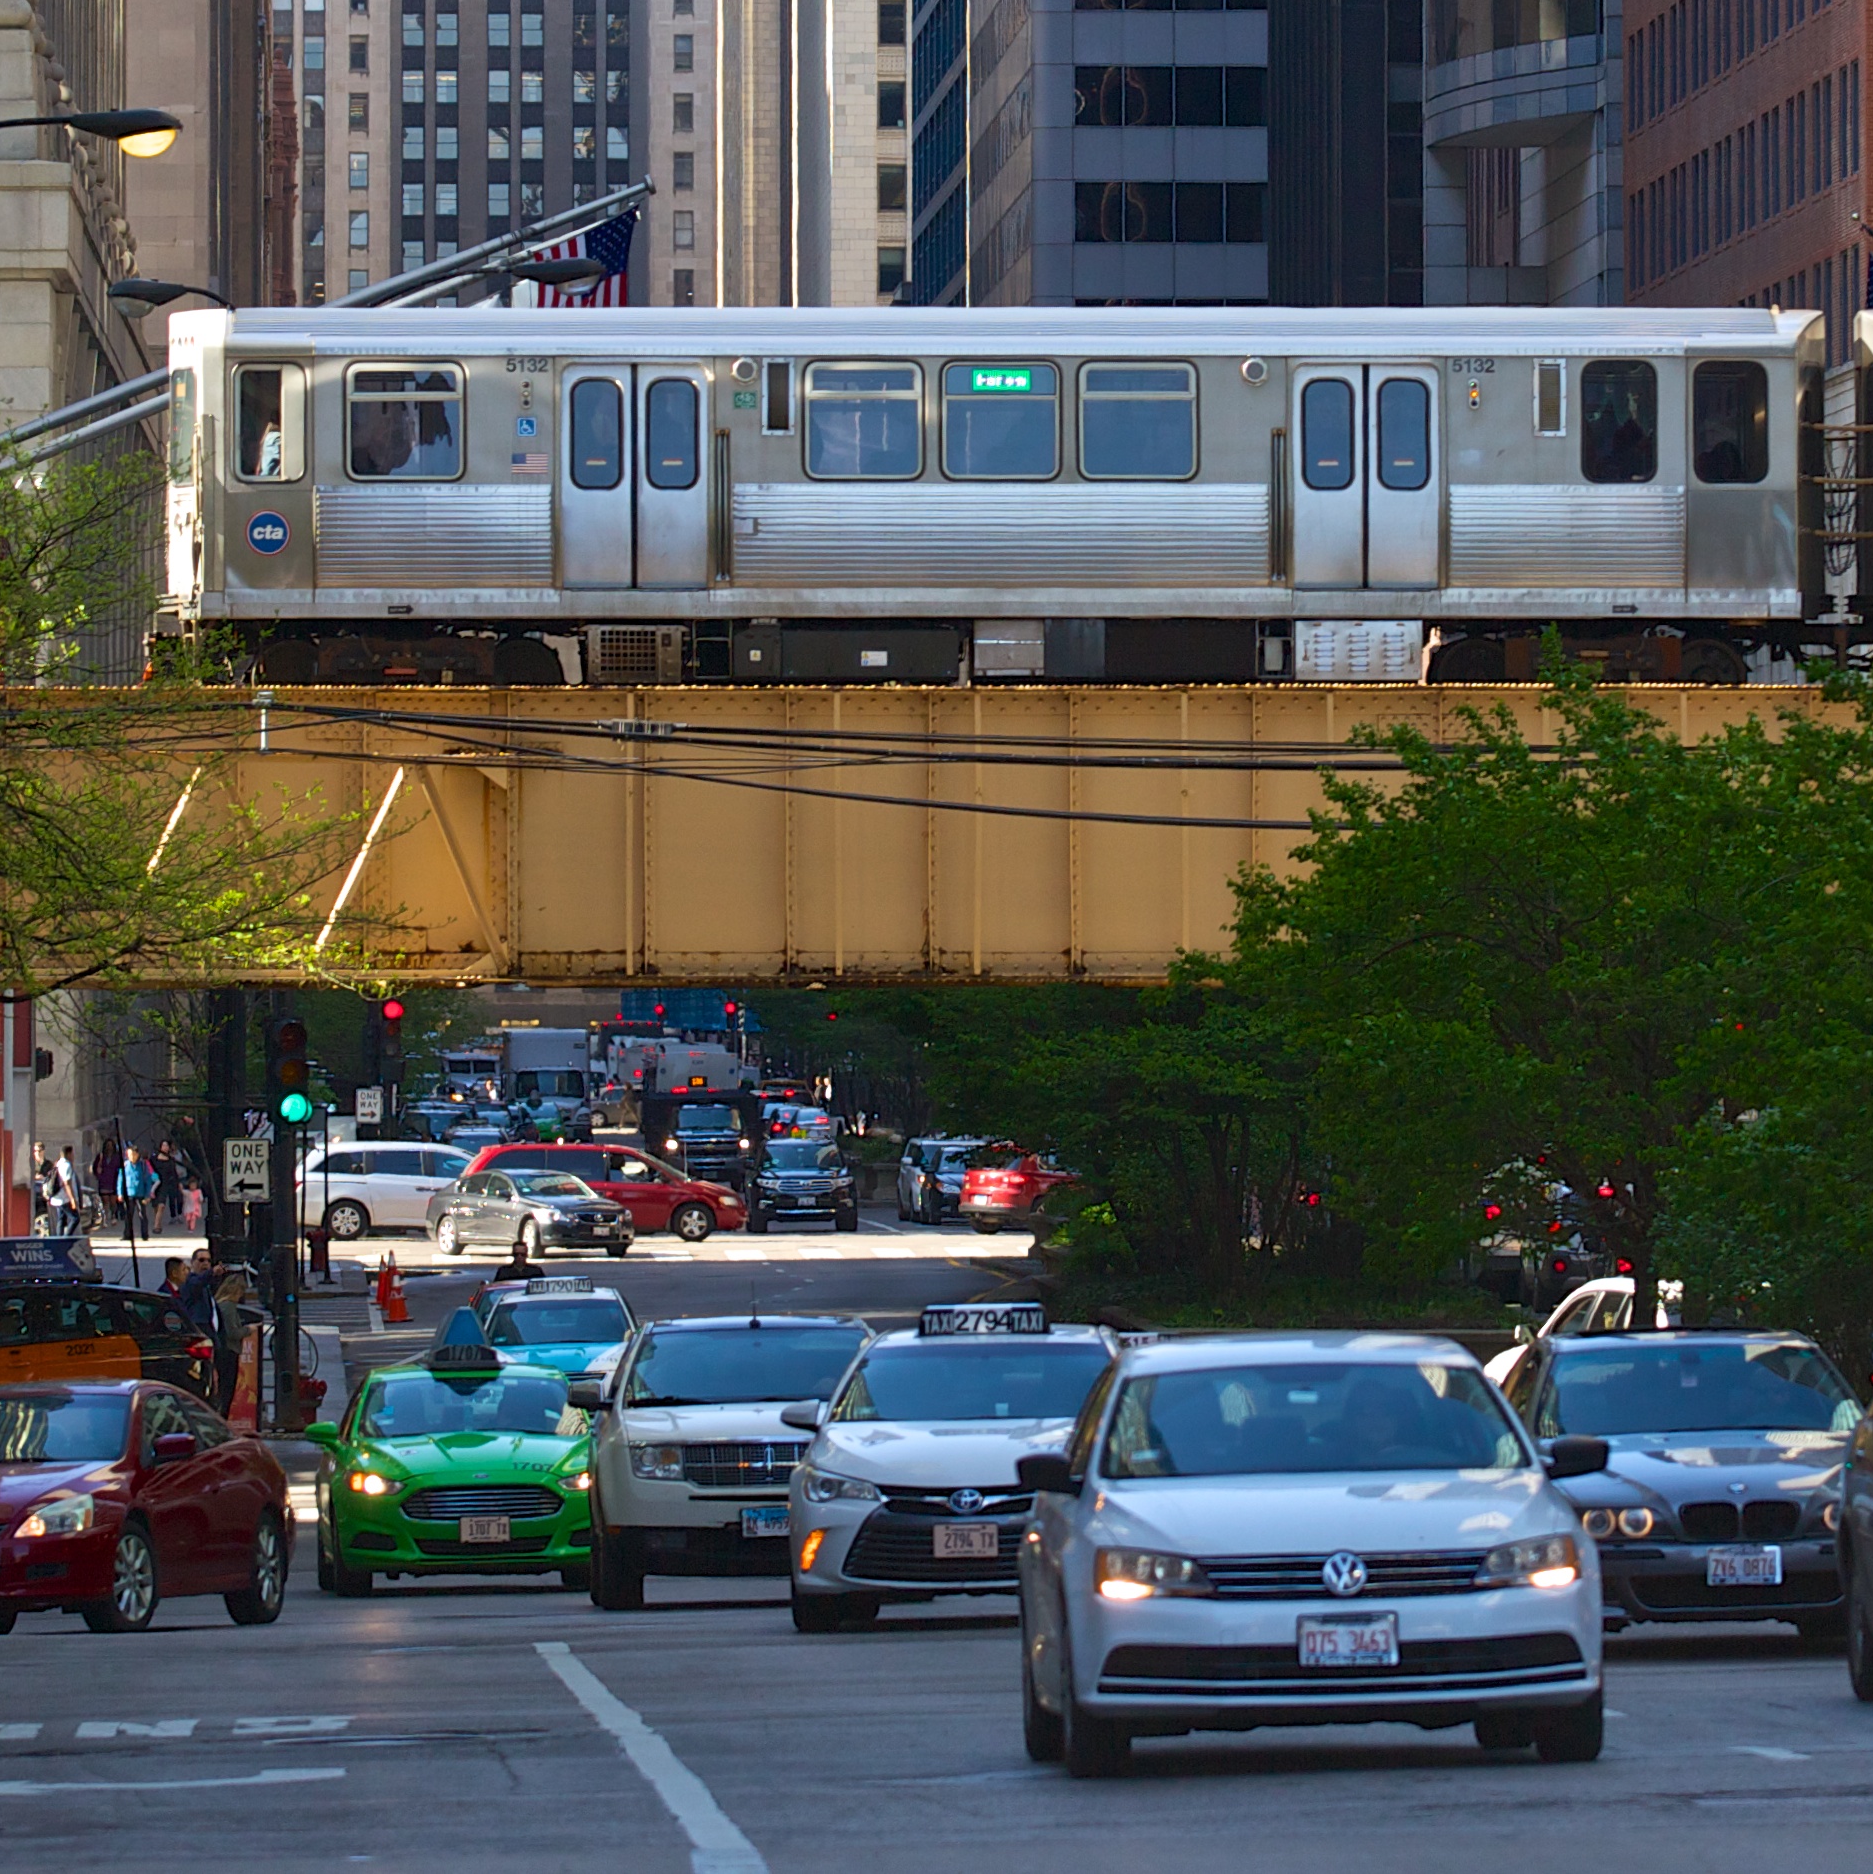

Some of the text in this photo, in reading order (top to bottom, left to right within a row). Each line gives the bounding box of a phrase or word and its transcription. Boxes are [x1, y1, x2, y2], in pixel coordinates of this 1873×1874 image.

[505, 358, 549, 373] 5132
[1452, 358, 1495, 373] 5132
[252, 524, 284, 541] cta
[360, 1091, 378, 1100] ONE
[360, 1101, 378, 1109] WAY
[231, 1143, 264, 1158] ONE
[230, 1160, 265, 1174] WAY
[10, 1250, 55, 1262] WINS
[546, 1280, 574, 1293] 1790
[923, 1310, 1044, 1334] TAXI 2794 TAXI
[65, 1343, 95, 1356] 2021
[512, 1462, 554, 1472] 1707
[468, 1523, 491, 1536] 1707
[944, 1532, 995, 1549] 2794 TX
